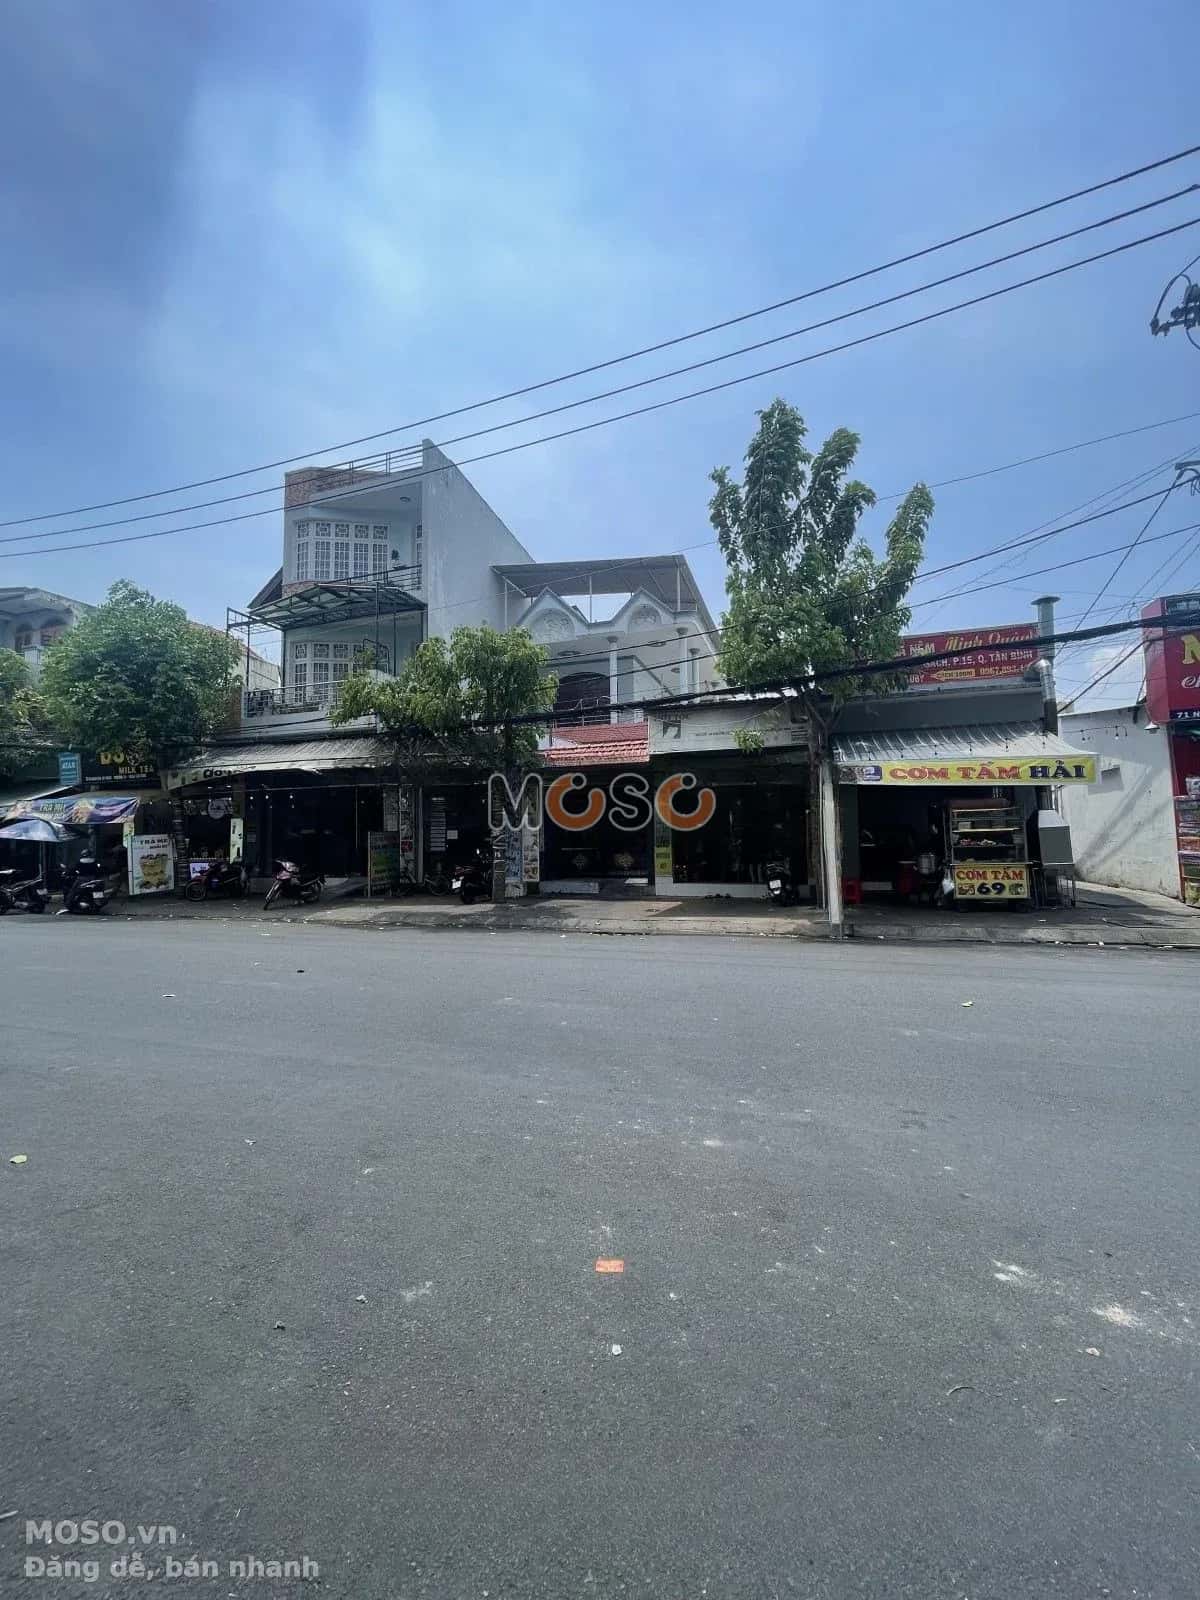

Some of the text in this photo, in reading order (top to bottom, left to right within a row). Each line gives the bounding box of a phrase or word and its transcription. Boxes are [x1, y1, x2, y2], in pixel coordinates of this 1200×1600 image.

[889, 759, 1087, 780] CƠM TẤM HẢI
[956, 869, 988, 881] CƠM
[976, 881, 1006, 896] 69
